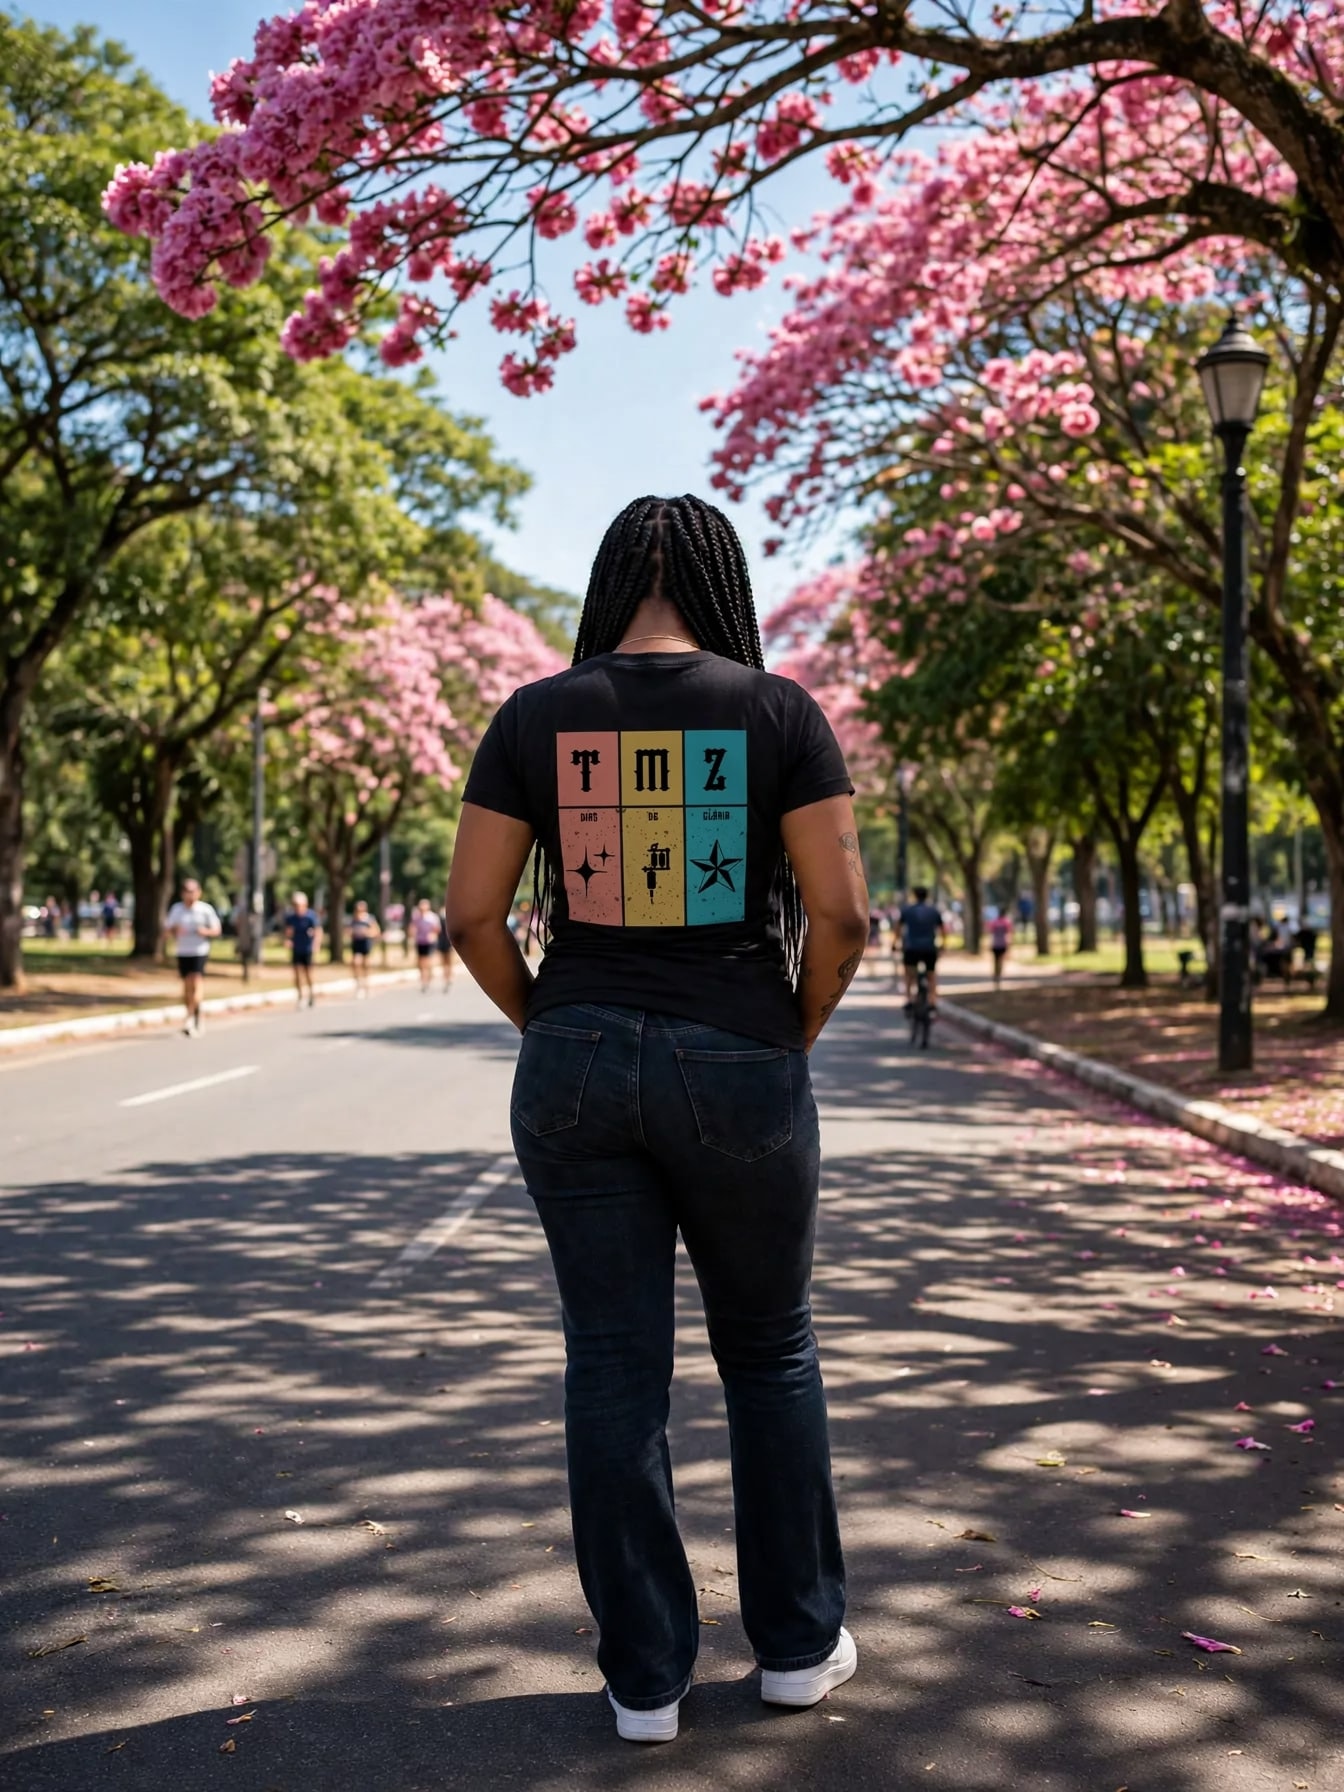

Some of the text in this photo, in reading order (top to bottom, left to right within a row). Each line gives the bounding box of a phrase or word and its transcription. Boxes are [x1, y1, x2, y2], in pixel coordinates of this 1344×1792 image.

[571, 749, 601, 792] T
[703, 748, 728, 791] Z
[648, 812, 659, 821] DE
